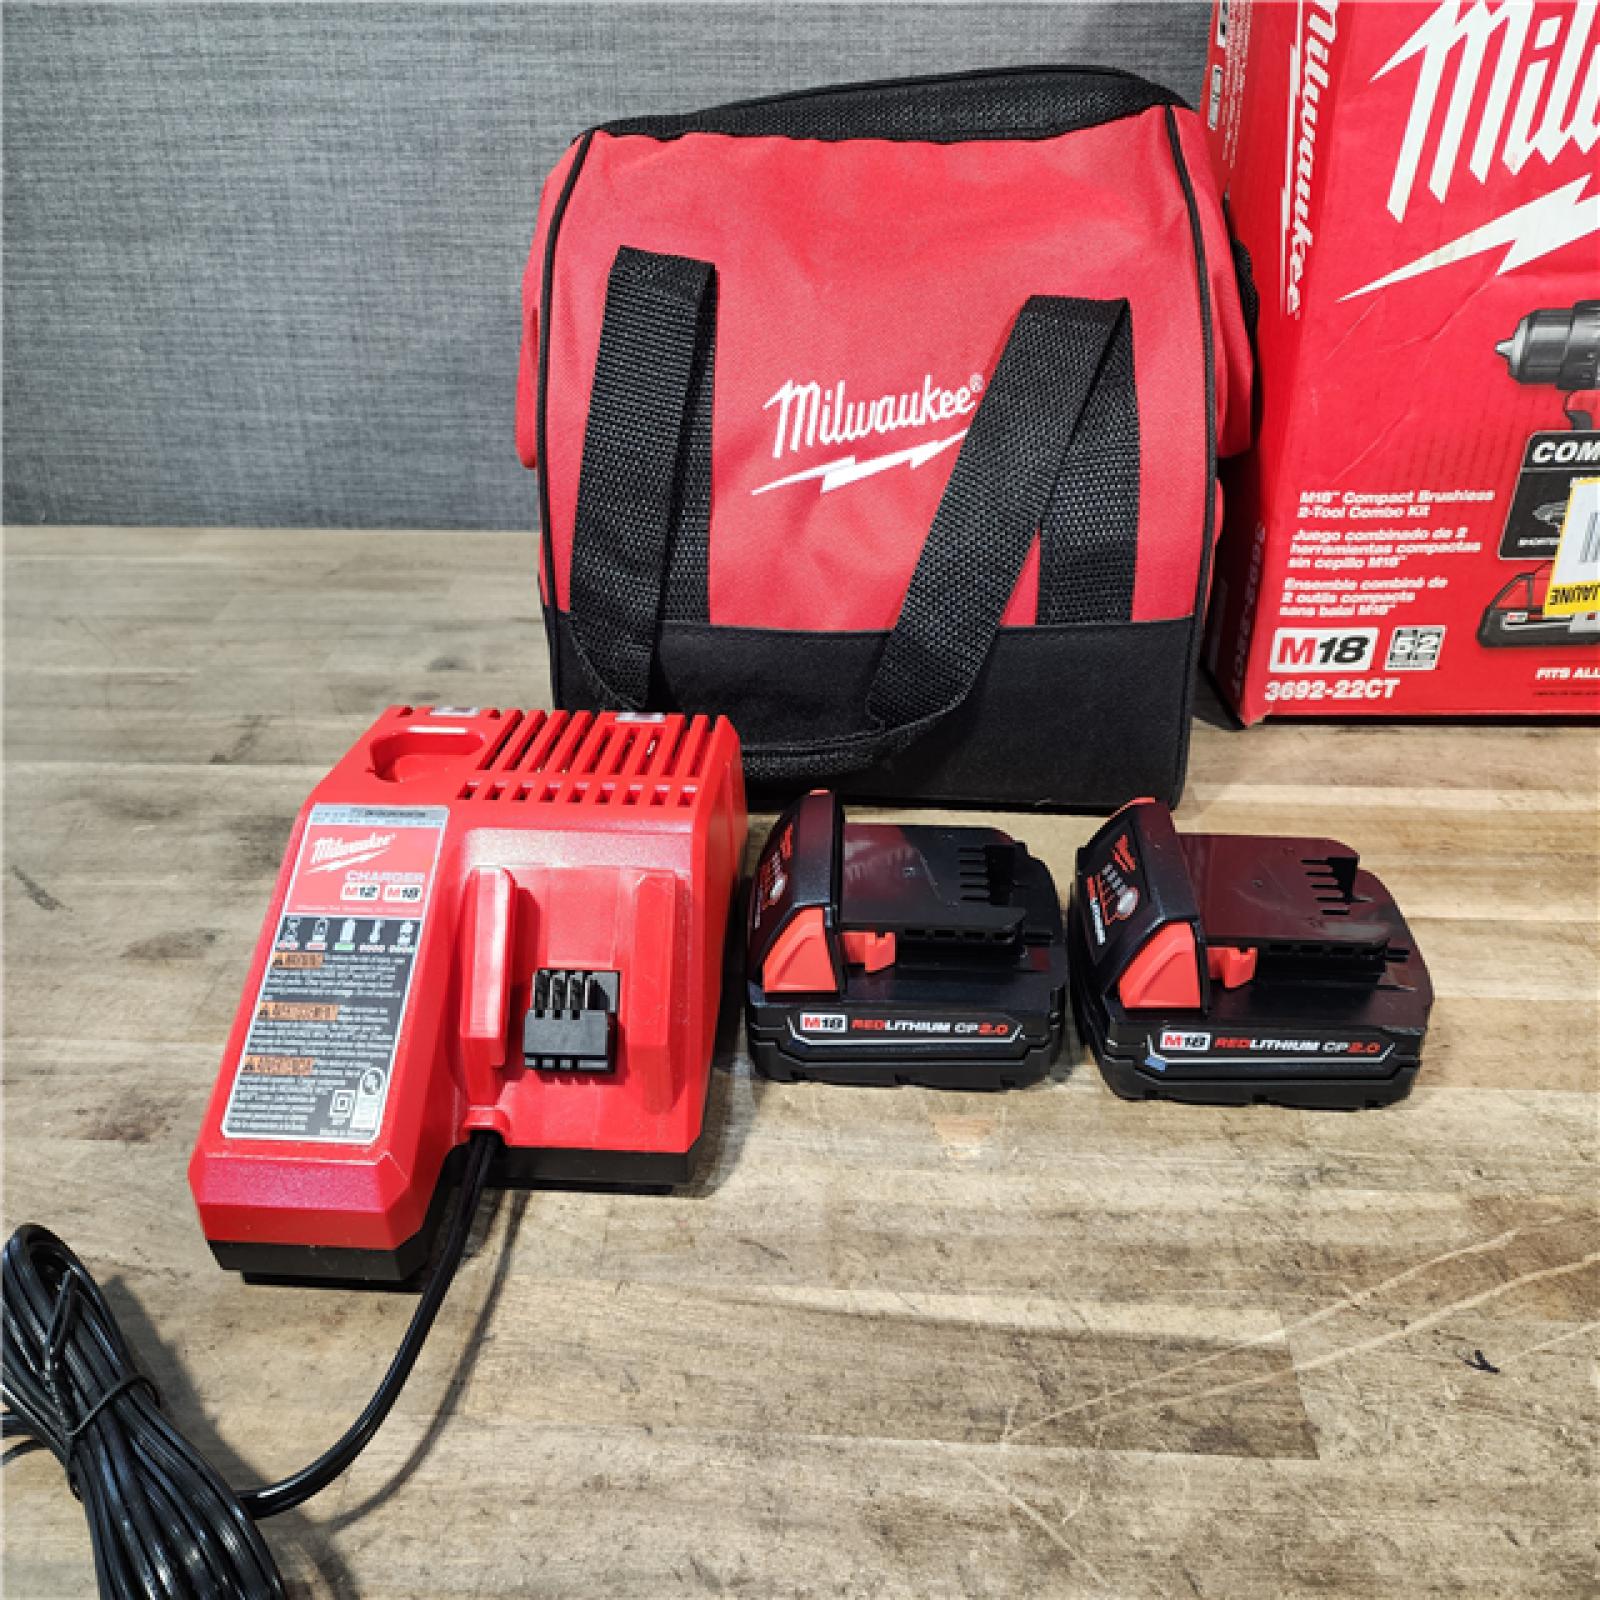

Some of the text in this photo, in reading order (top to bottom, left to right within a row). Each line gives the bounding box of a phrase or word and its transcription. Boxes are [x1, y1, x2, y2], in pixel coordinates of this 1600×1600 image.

[1343, 490, 1414, 505] Compact
[1348, 506, 1405, 518] Combo
[1277, 635, 1370, 665] M18
[1534, 667, 1571, 680] FITS
[1264, 677, 1400, 700] 3692-22CT
[852, 1019, 951, 1033] REDLITHIUM
